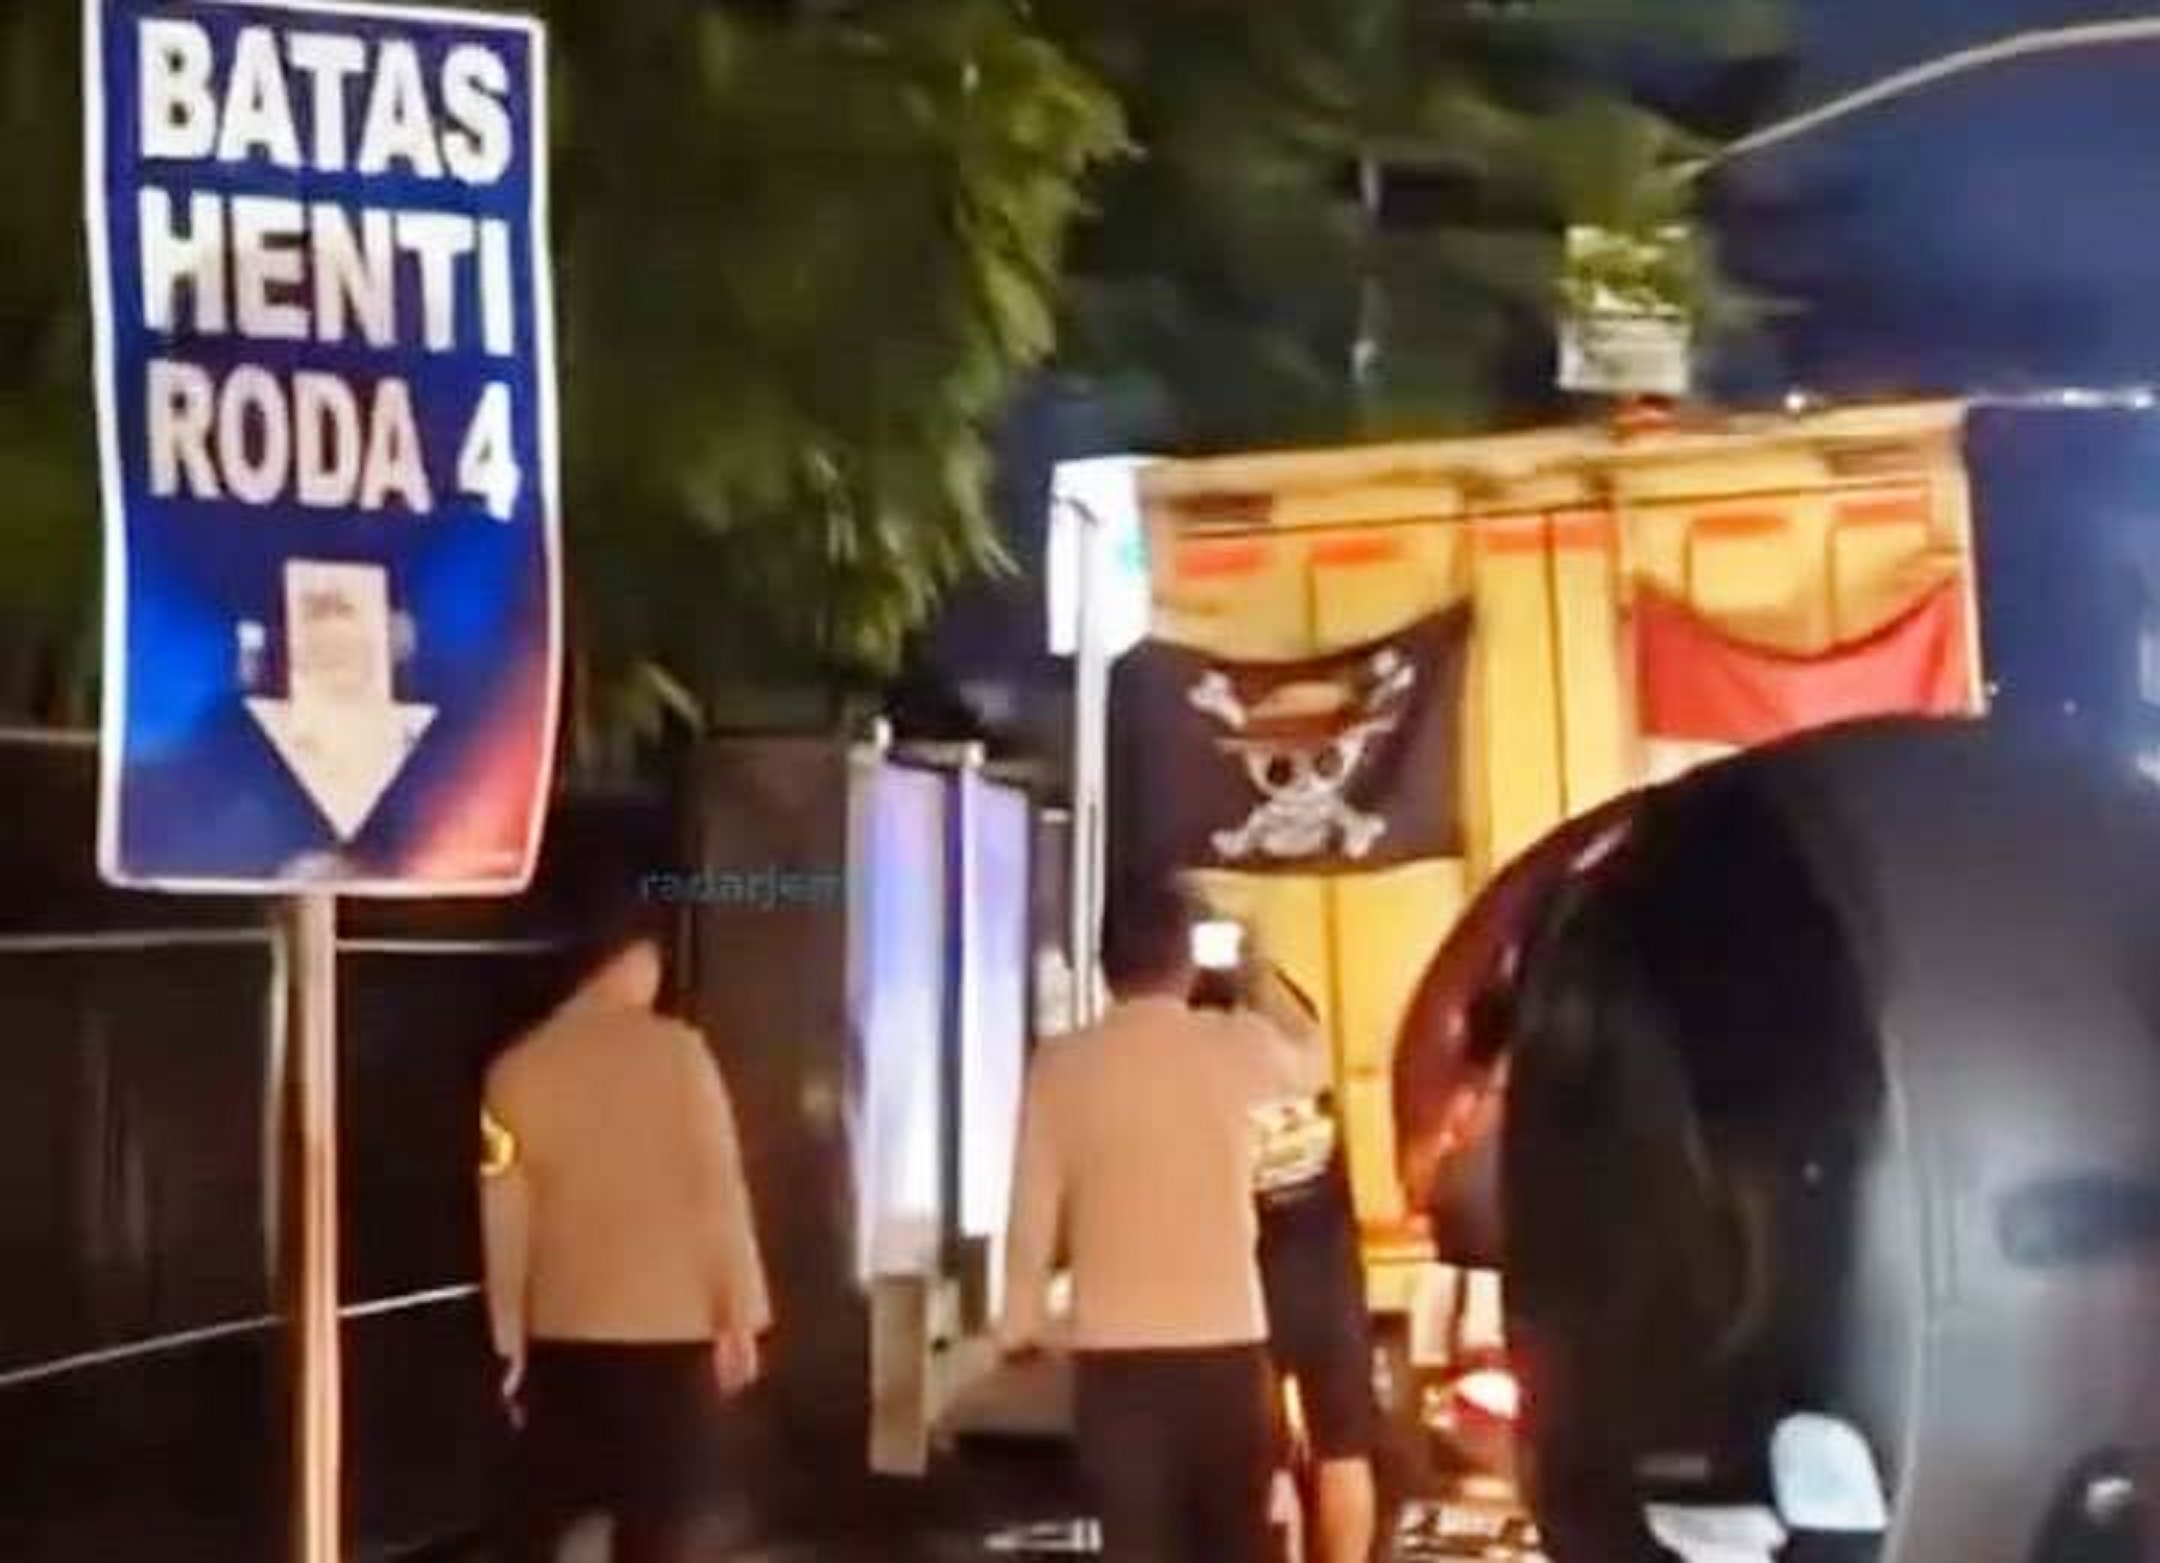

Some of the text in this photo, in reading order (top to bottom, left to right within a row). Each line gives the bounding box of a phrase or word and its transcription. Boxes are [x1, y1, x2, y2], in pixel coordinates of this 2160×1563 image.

[137, 17, 514, 184] BATAS
[138, 186, 514, 356] HENTI
[146, 358, 519, 521] RODA 4
